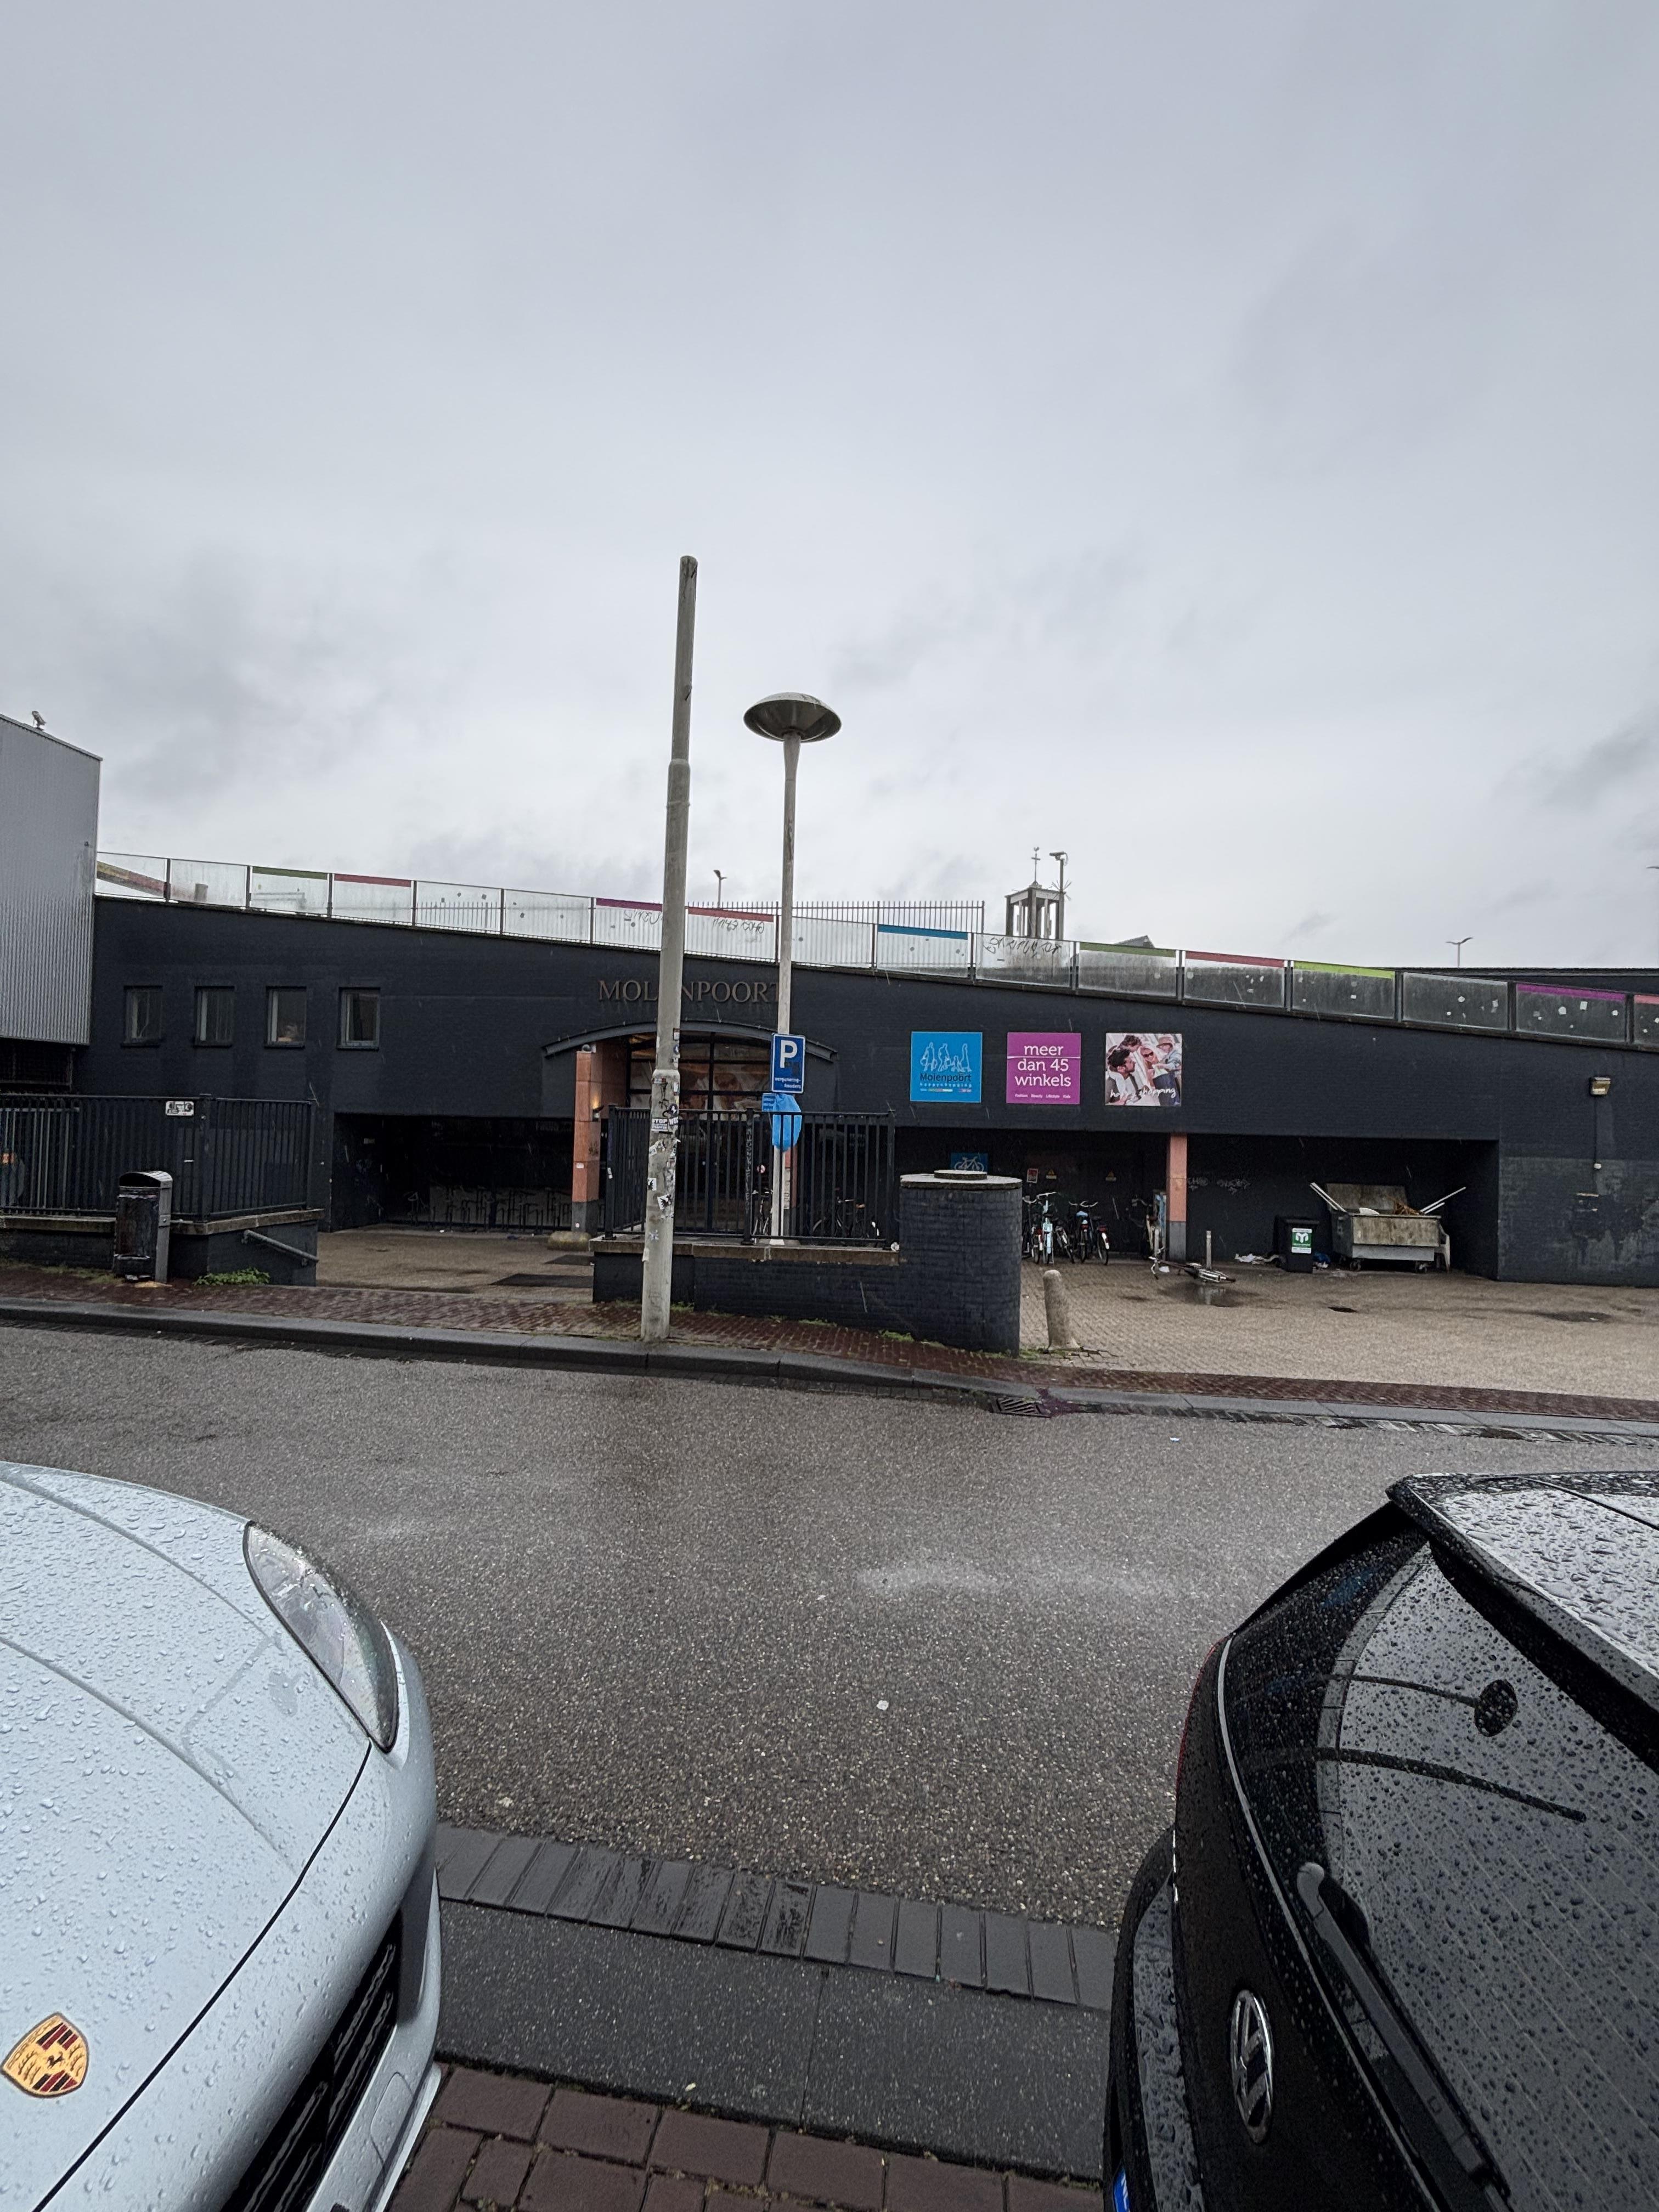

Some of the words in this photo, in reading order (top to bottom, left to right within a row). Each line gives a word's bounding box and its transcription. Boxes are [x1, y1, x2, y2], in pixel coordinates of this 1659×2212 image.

[599, 980, 779, 1003] MOLNPOORT
[780, 1040, 798, 1069] P
[1024, 1045, 1064, 1056] meer
[1018, 1058, 1046, 1071] dan
[1050, 1058, 1069, 1071] 45
[919, 1073, 972, 1084] Molenpoort
[1014, 1073, 1071, 1087] winkels
